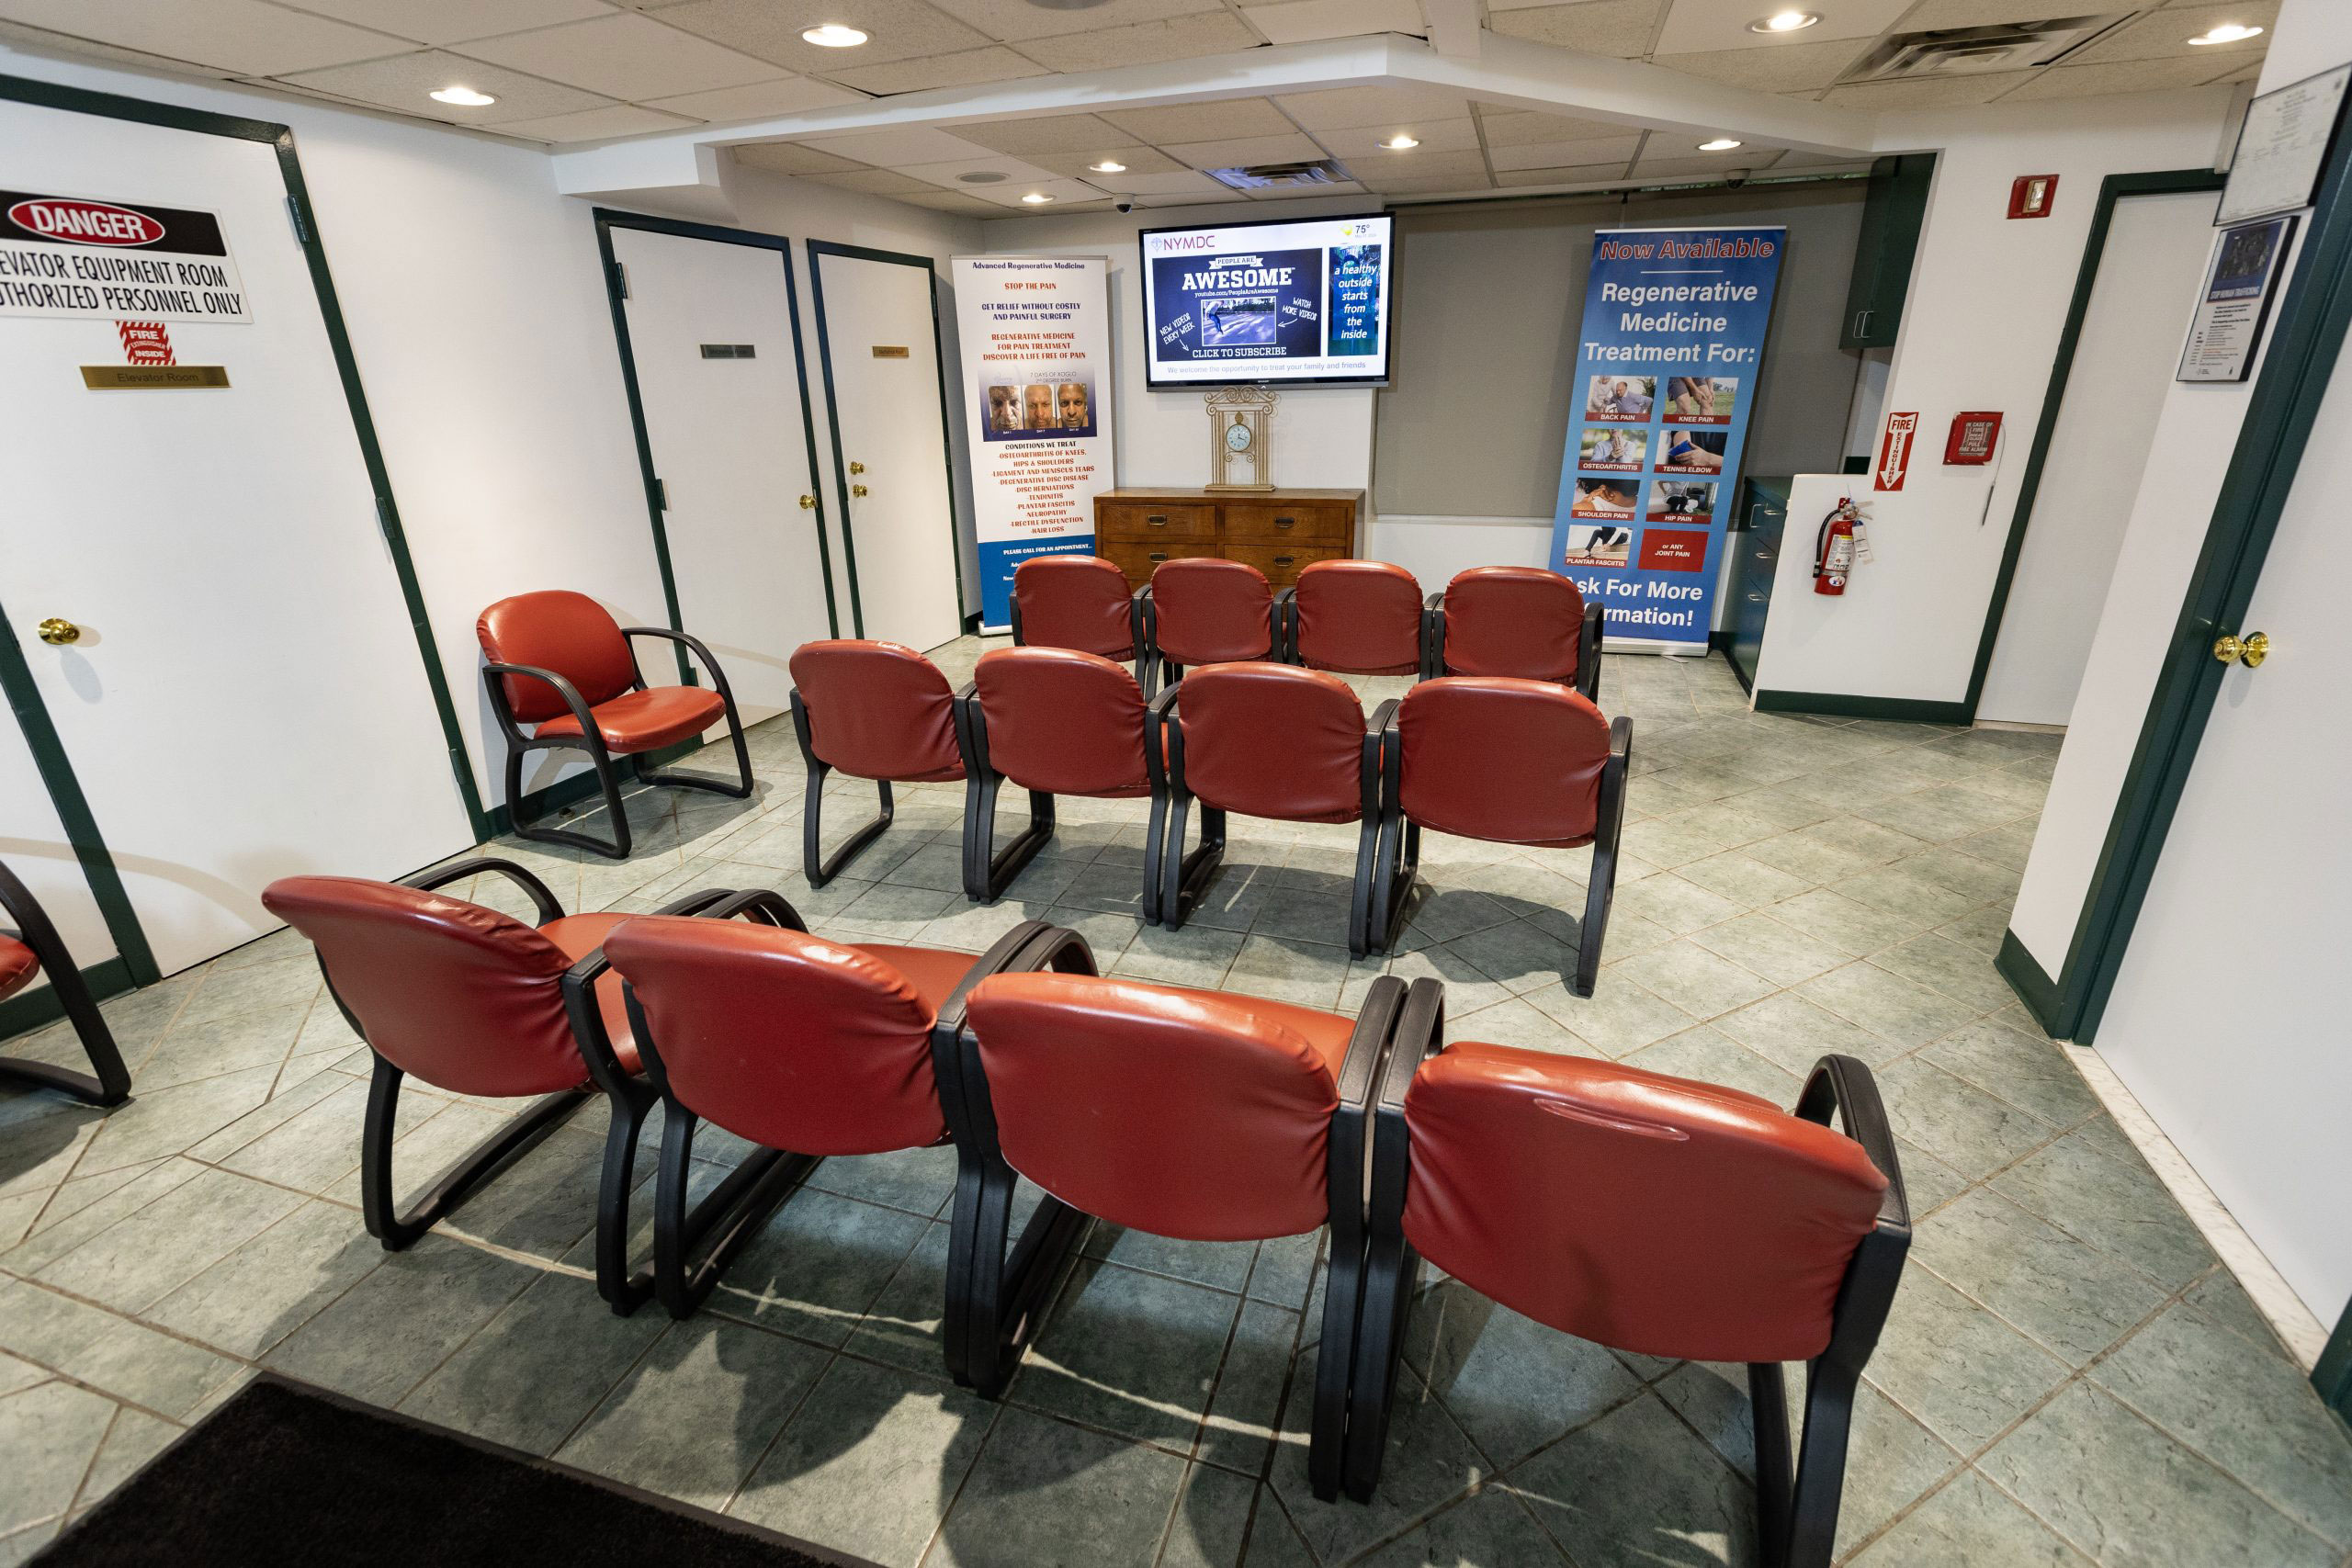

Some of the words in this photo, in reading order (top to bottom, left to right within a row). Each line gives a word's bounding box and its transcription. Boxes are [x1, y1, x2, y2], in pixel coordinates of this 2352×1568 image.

[29, 204, 148, 240] DANGER
[1164, 235, 1215, 250] NYMDC
[1600, 241, 1655, 261] Now
[1657, 237, 1775, 259] Available
[73, 255, 177, 285] EQUIPMENT
[176, 263, 228, 288] ROOM
[1007, 262, 1053, 270] Regenerative
[1342, 264, 1377, 275] healthy
[1182, 267, 1293, 290] AWESOME
[1339, 277, 1373, 288] outside
[1341, 291, 1368, 300] starts
[1601, 280, 1758, 306] Regenerative
[102, 287, 203, 314] PERSONNEL
[203, 291, 243, 315] ONLY
[1293, 297, 1312, 309] WATCH
[1282, 305, 1297, 315] MORE
[1298, 310, 1317, 321] VIDEOS
[1343, 303, 1366, 314] from
[1159, 323, 1172, 336] NEW
[1172, 312, 1191, 328] VIDEOS
[1347, 316, 1363, 326] the
[1620, 312, 1727, 333] Medicine
[129, 330, 160, 340] FIRE
[1163, 330, 1179, 344] EVERY
[1179, 321, 1195, 334] WEEK
[1341, 329, 1367, 339] inside
[1193, 349, 1220, 358] CLICK
[1220, 348, 1233, 357] TO
[1235, 346, 1287, 356] SUBSCRIBE
[1584, 342, 1702, 361] Treatment
[1707, 343, 1755, 363] For:
[1221, 365, 1260, 373] opportunity
[1305, 362, 1325, 370] family
[117, 372, 164, 382] Elevator
[167, 372, 198, 382] Room
[1892, 419, 1912, 430] FIRE
[1005, 442, 1045, 450] CONDITIONS
[1887, 432, 1903, 484] EXTINGUISHER
[1582, 463, 1638, 471] OSTEOARTHRITIS
[1041, 516, 1084, 525] DYSFUNCTION
[1577, 511, 1611, 519] SHOULDER
[1612, 512, 1629, 520] PAIN
[1566, 558, 1595, 566] PLANTAR
[1605, 578, 1643, 597] For
[1647, 581, 1703, 601] More
